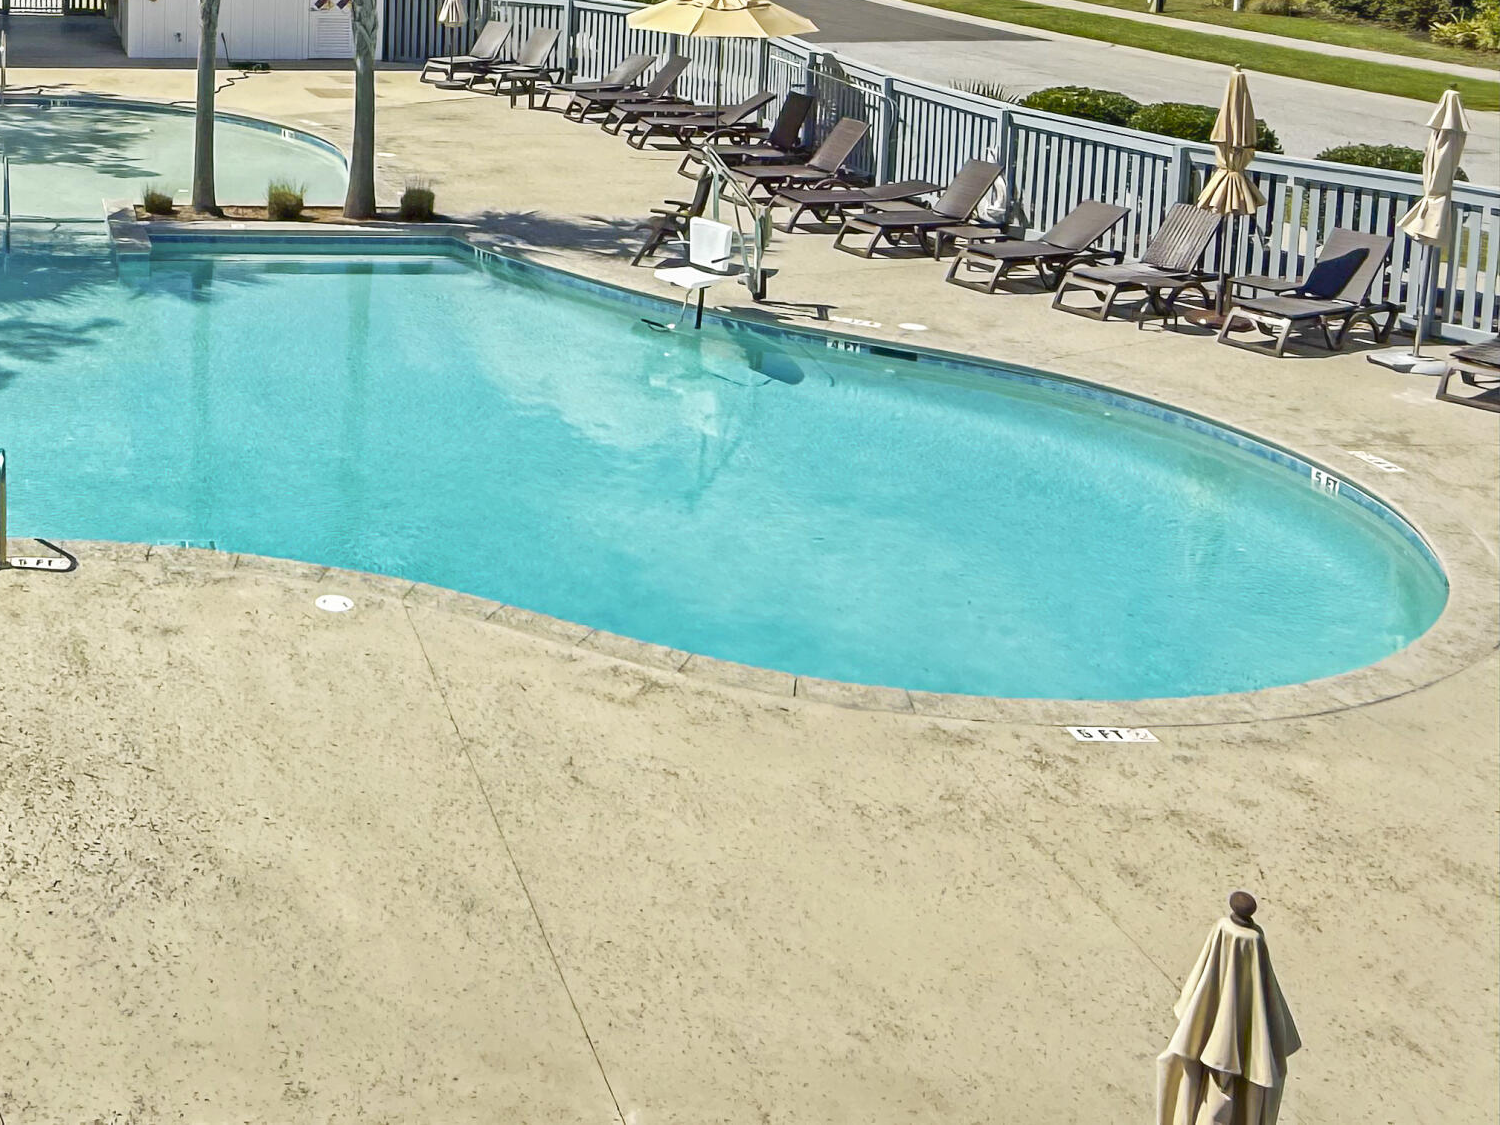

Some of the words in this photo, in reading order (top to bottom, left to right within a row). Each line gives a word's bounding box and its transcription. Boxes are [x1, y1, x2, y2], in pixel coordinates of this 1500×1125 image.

[1315, 471, 1322, 483] 5
[1326, 476, 1338, 490] FT
[1098, 729, 1124, 740] FT
